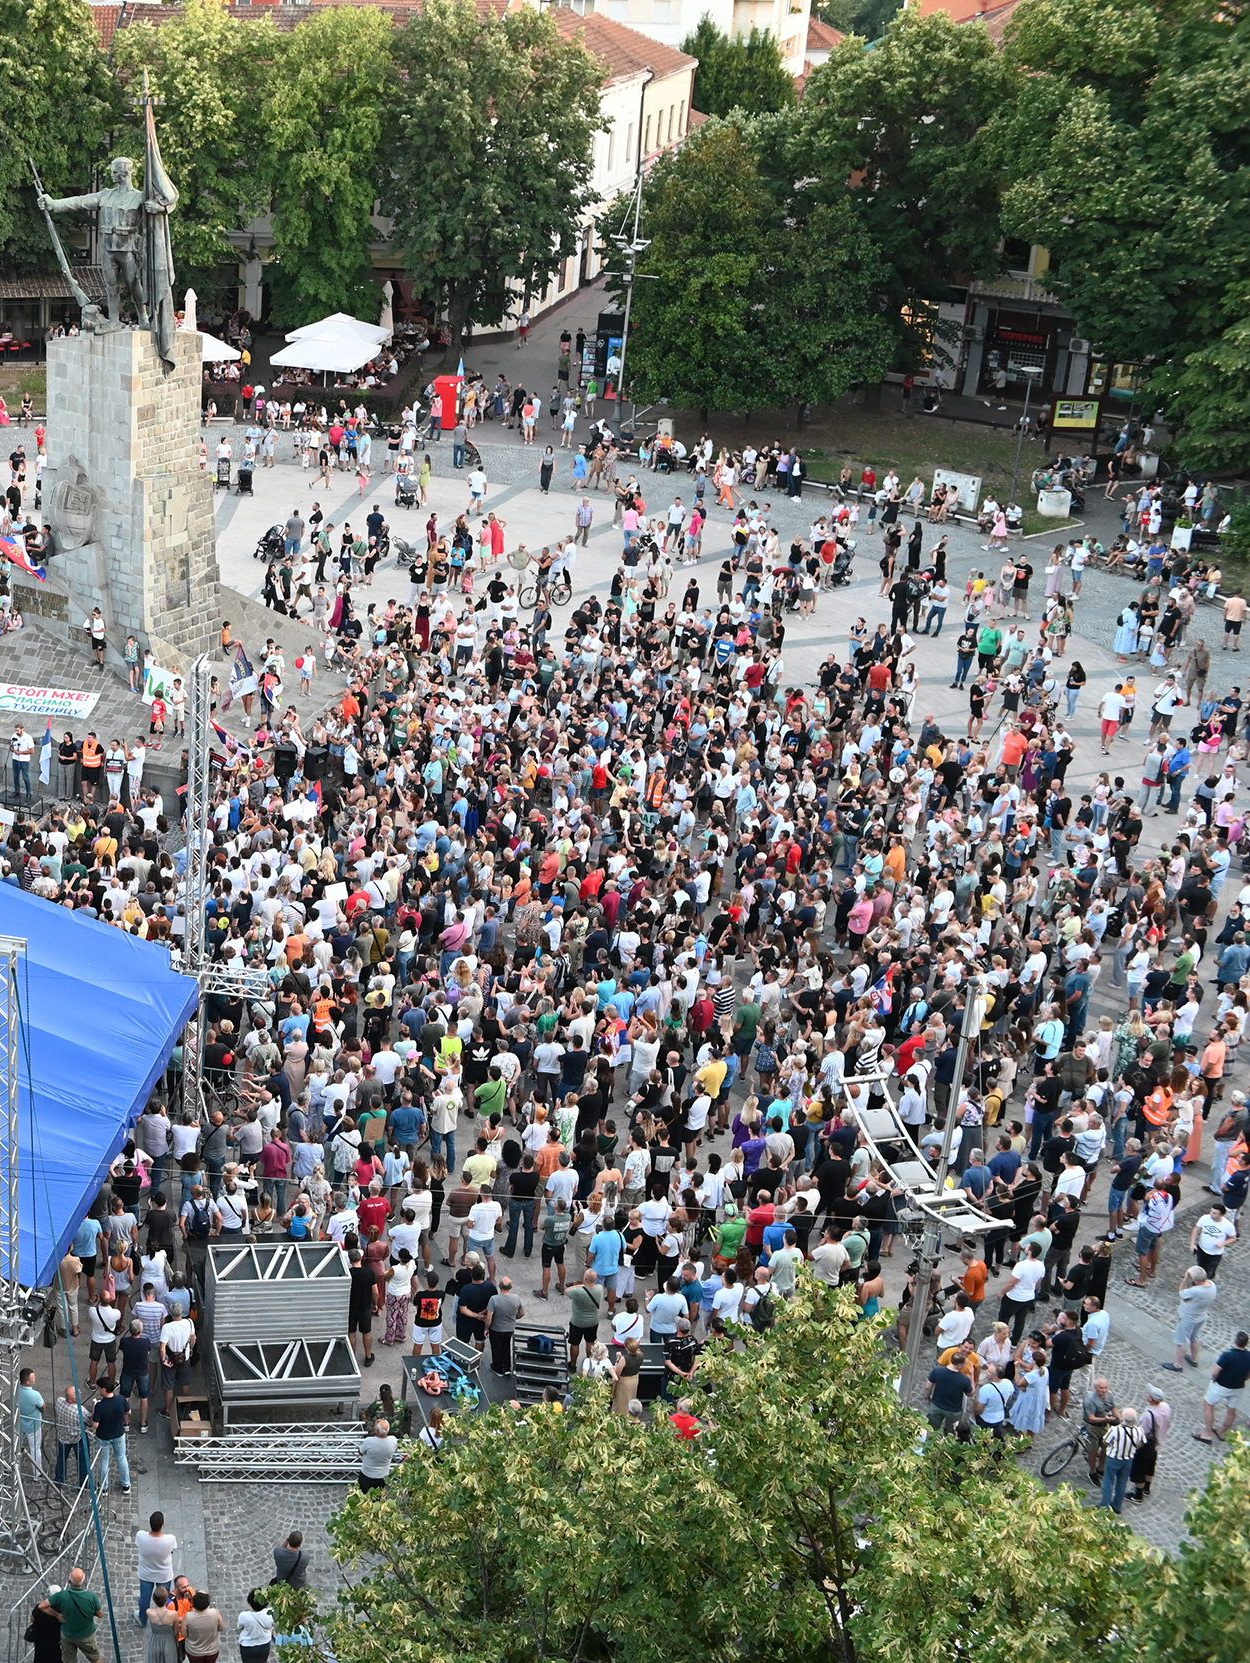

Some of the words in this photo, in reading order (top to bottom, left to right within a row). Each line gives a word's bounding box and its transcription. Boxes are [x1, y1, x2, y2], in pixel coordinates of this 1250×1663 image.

[6, 686, 48, 698] СТОП
[50, 690, 90, 702] МХЕ!
[341, 1222, 355, 1235] 23
